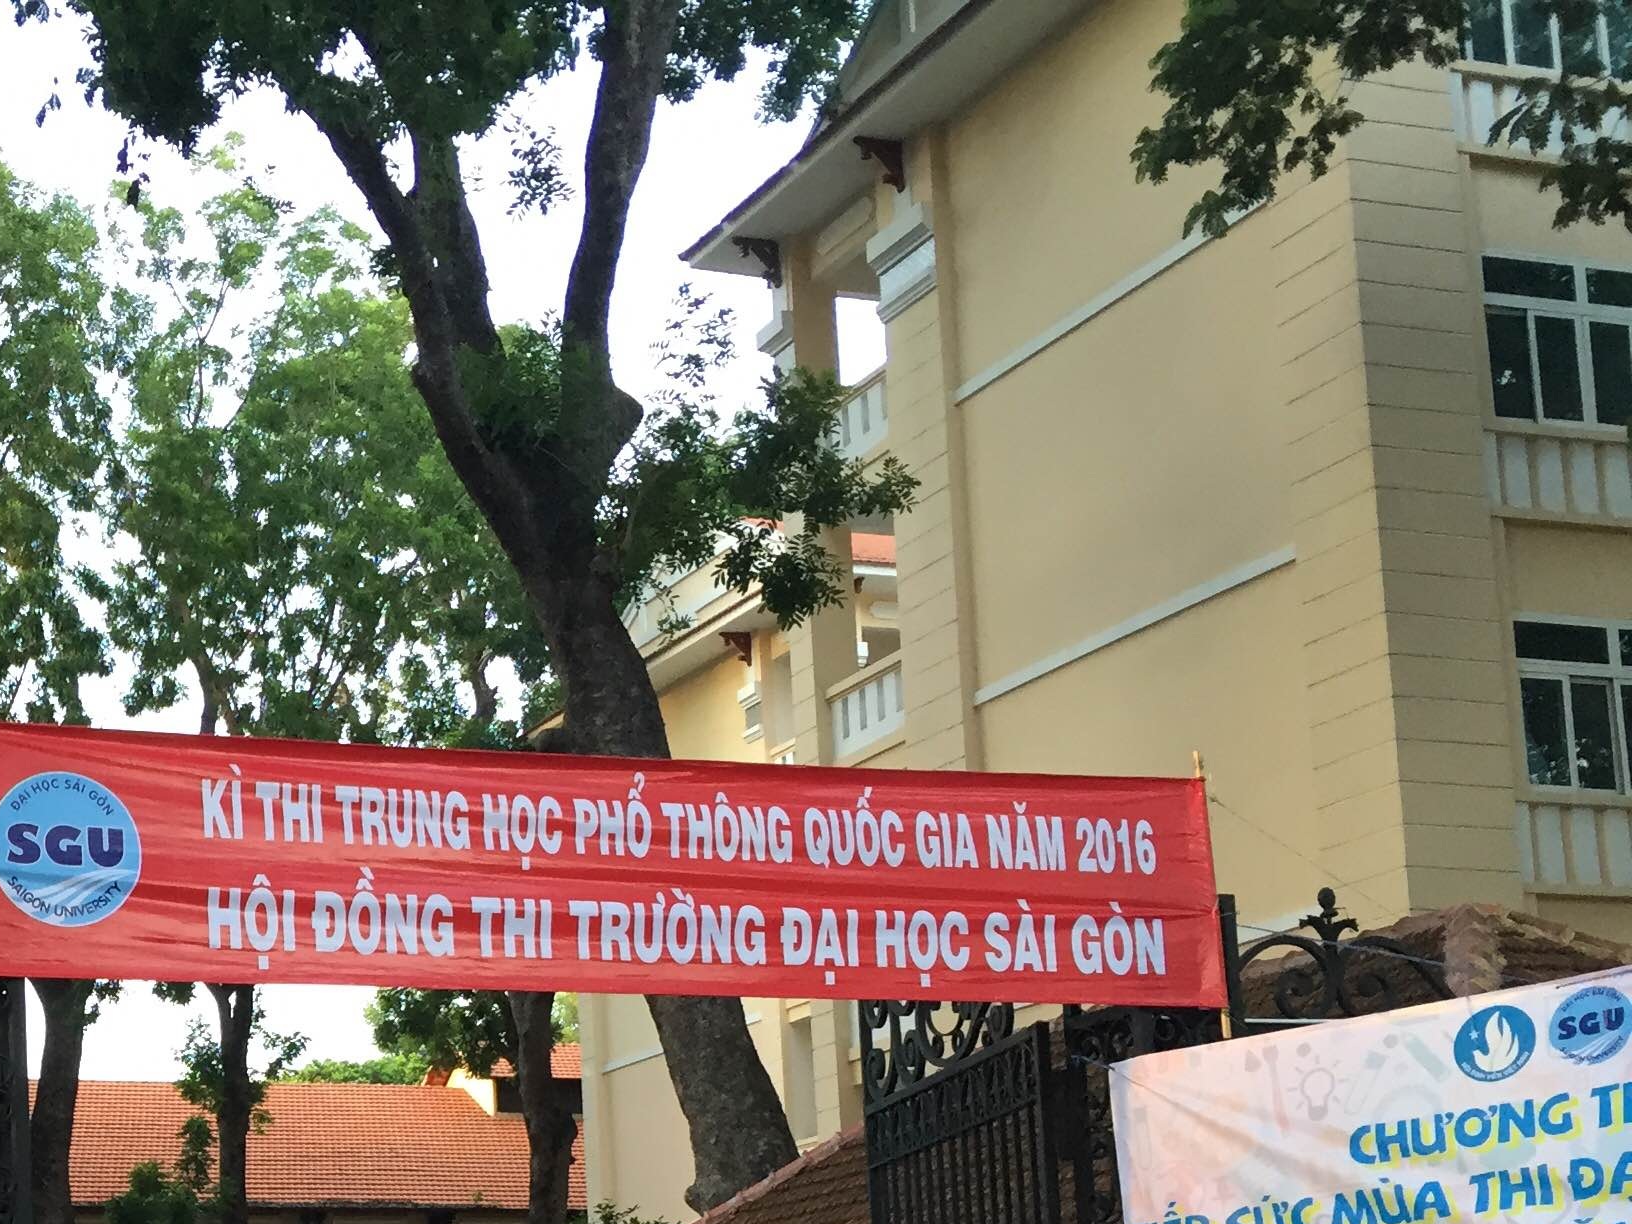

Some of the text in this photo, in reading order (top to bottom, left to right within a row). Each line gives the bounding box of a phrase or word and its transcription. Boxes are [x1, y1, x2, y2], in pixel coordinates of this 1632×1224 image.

[7, 822, 124, 868] SGU
[201, 764, 1157, 875] KÌ THI TRUNG HỌC PHỔ THÔNG QUỐC GIA NĂM 2016
[7, 875, 123, 918] SAIGON UNIVERSITY
[207, 866, 1167, 987] HỘI ĐỒNG THI TRƯỜNG ĐẠI HỌC SÀI GÒN
[1557, 1006, 1625, 1041] SGU
[1348, 1091, 1573, 1165] CHƯƠNG
[1469, 1163, 1554, 1214] THI
